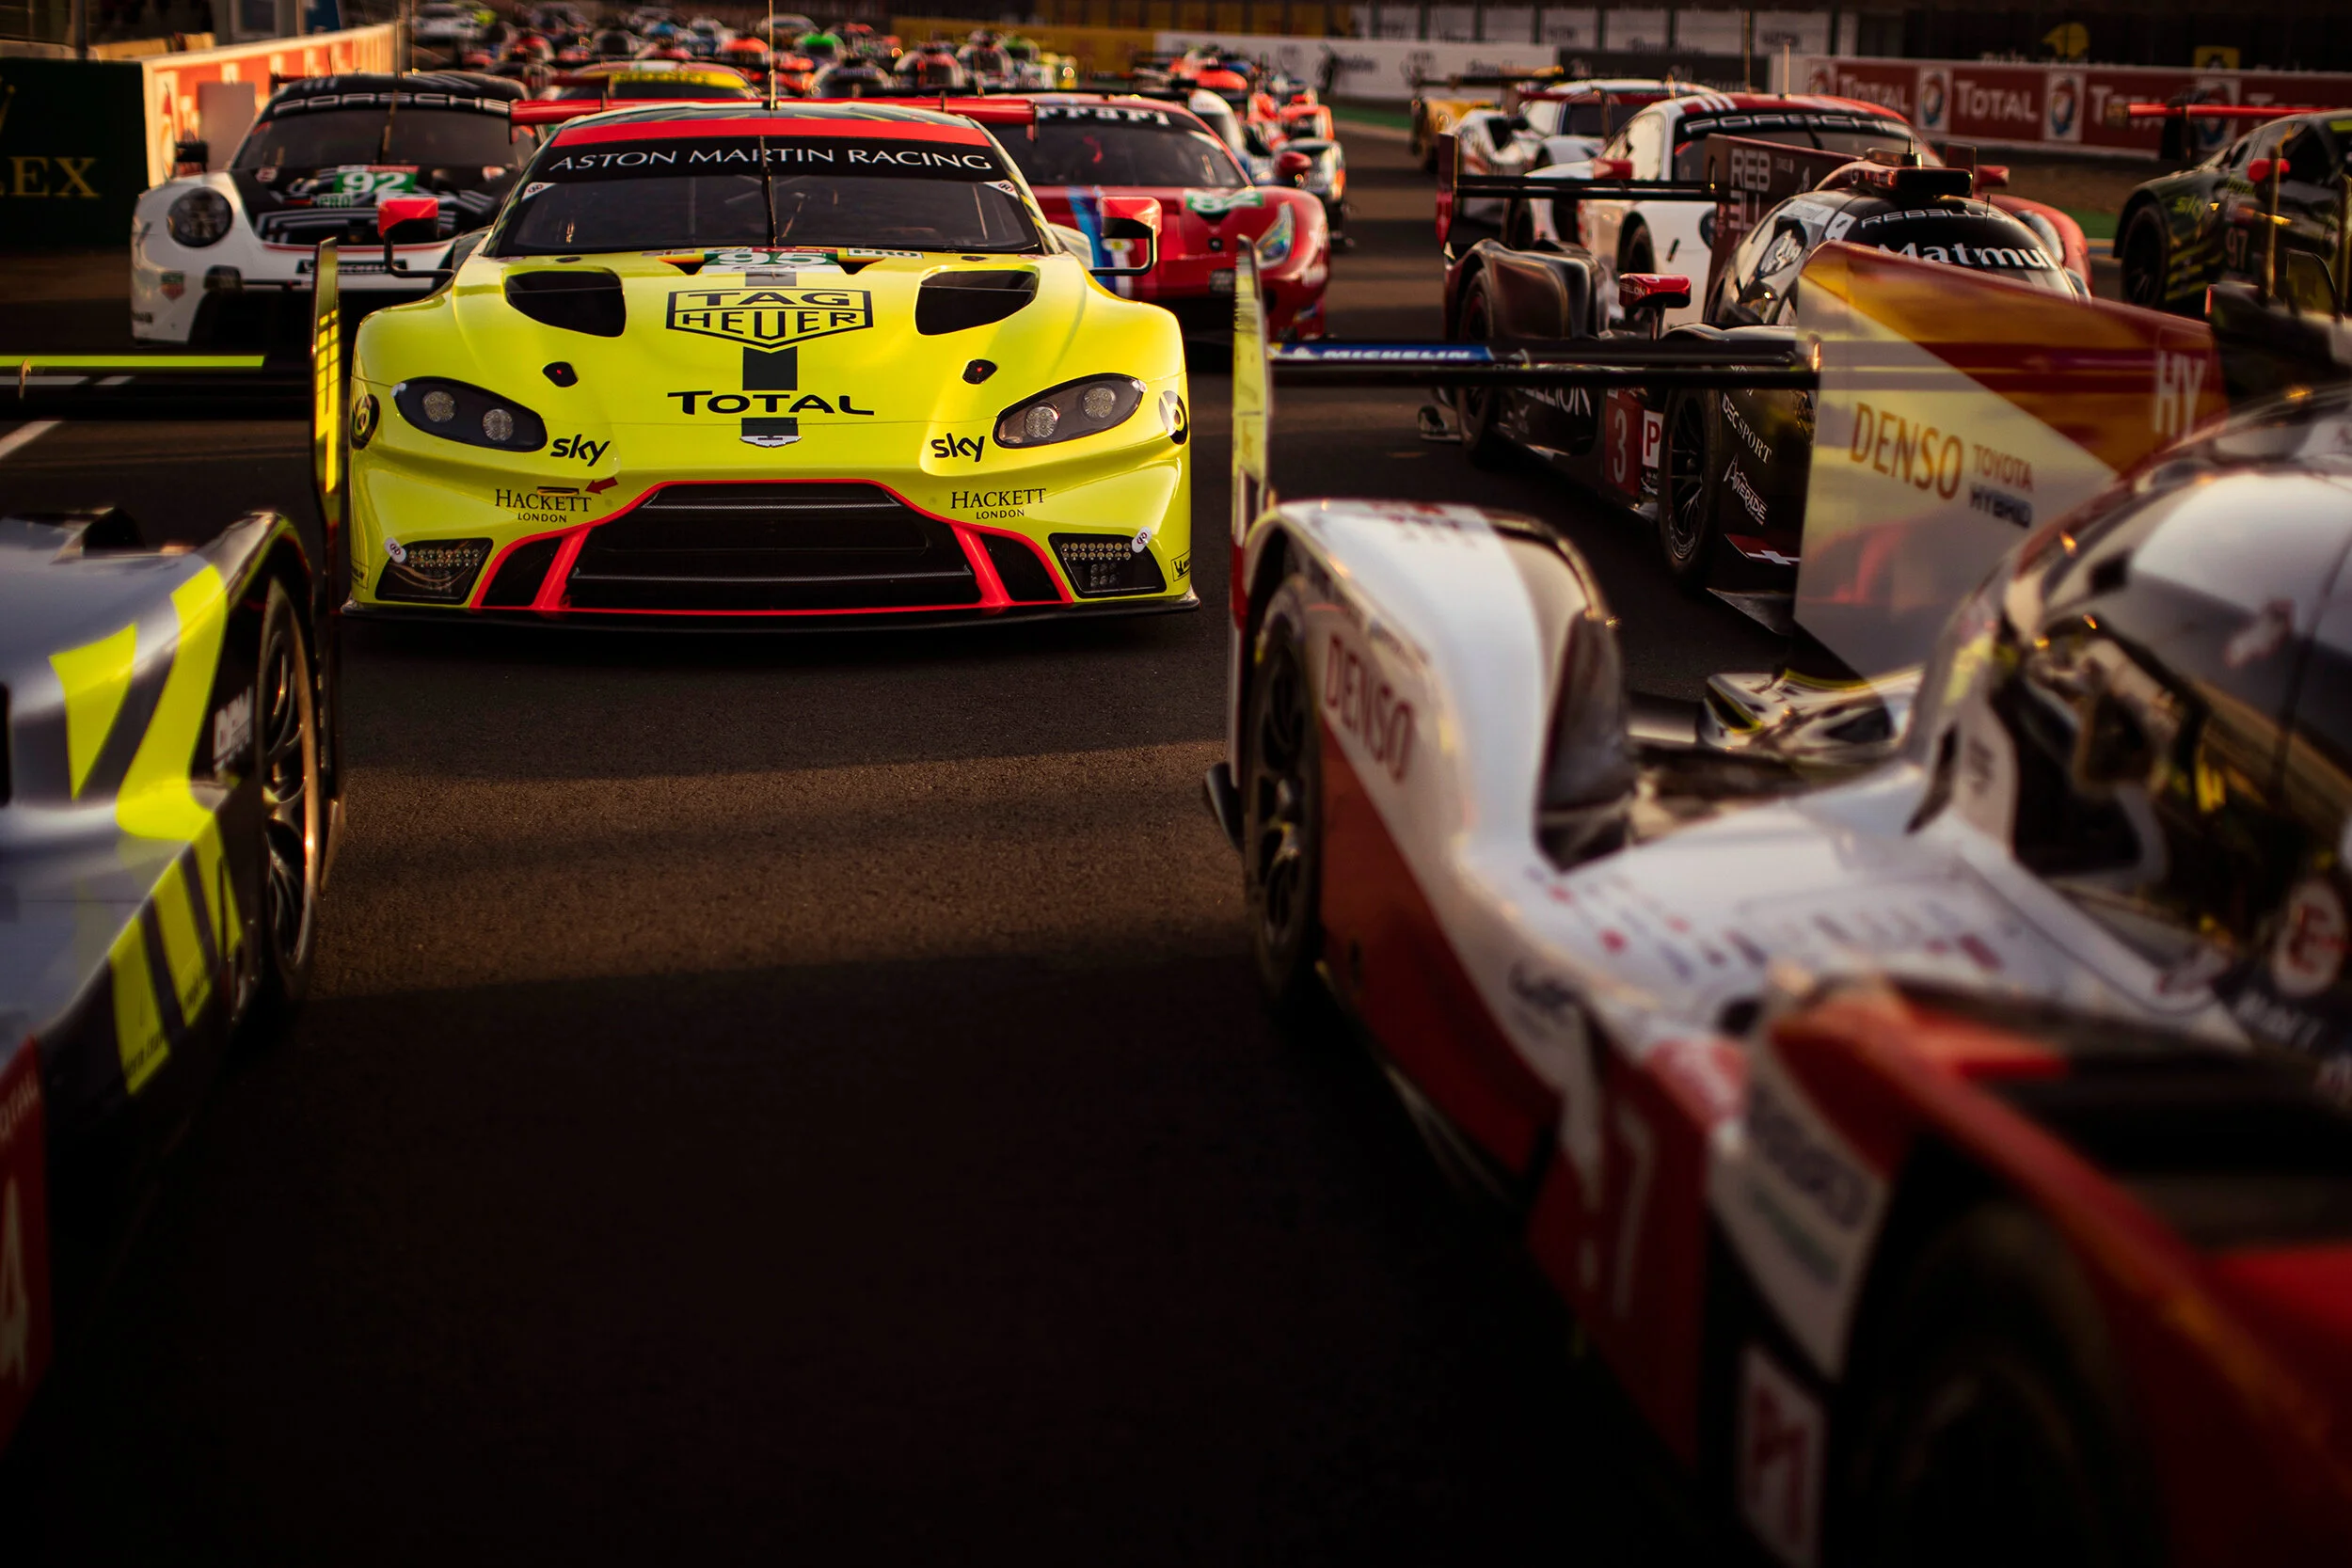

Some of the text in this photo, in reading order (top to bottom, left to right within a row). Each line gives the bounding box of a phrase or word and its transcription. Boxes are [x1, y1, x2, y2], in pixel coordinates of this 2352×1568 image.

[274, 92, 511, 116] PORSCHE
[1954, 79, 2040, 123] TOTAL
[1683, 113, 1914, 139] PORSCHE
[548, 148, 993, 172] ASTON MARTIN RACING
[0, 155, 102, 198] EX
[342, 171, 407, 193] 92
[717, 250, 828, 265] 95
[2225, 226, 2249, 271] 97
[688, 291, 851, 306] TAG
[681, 310, 858, 341] HEUER
[1321, 349, 1472, 360] MICHELIN
[667, 390, 875, 416] TOTAL
[550, 434, 611, 467] sky
[930, 433, 985, 462] sky
[1613, 408, 1628, 484] 3
[1646, 421, 1660, 457] P
[1737, 418, 1772, 465] SPORT
[1851, 402, 1963, 500] DENSO
[1973, 444, 2033, 493] TOYOTA
[495, 489, 592, 512] HACKETT
[951, 488, 1047, 509] HACKETT
[1969, 484, 2032, 528] HYBRID
[517, 513, 567, 523] LONDON
[976, 509, 1025, 520] LONDON
[1323, 632, 1414, 783] DENSO
